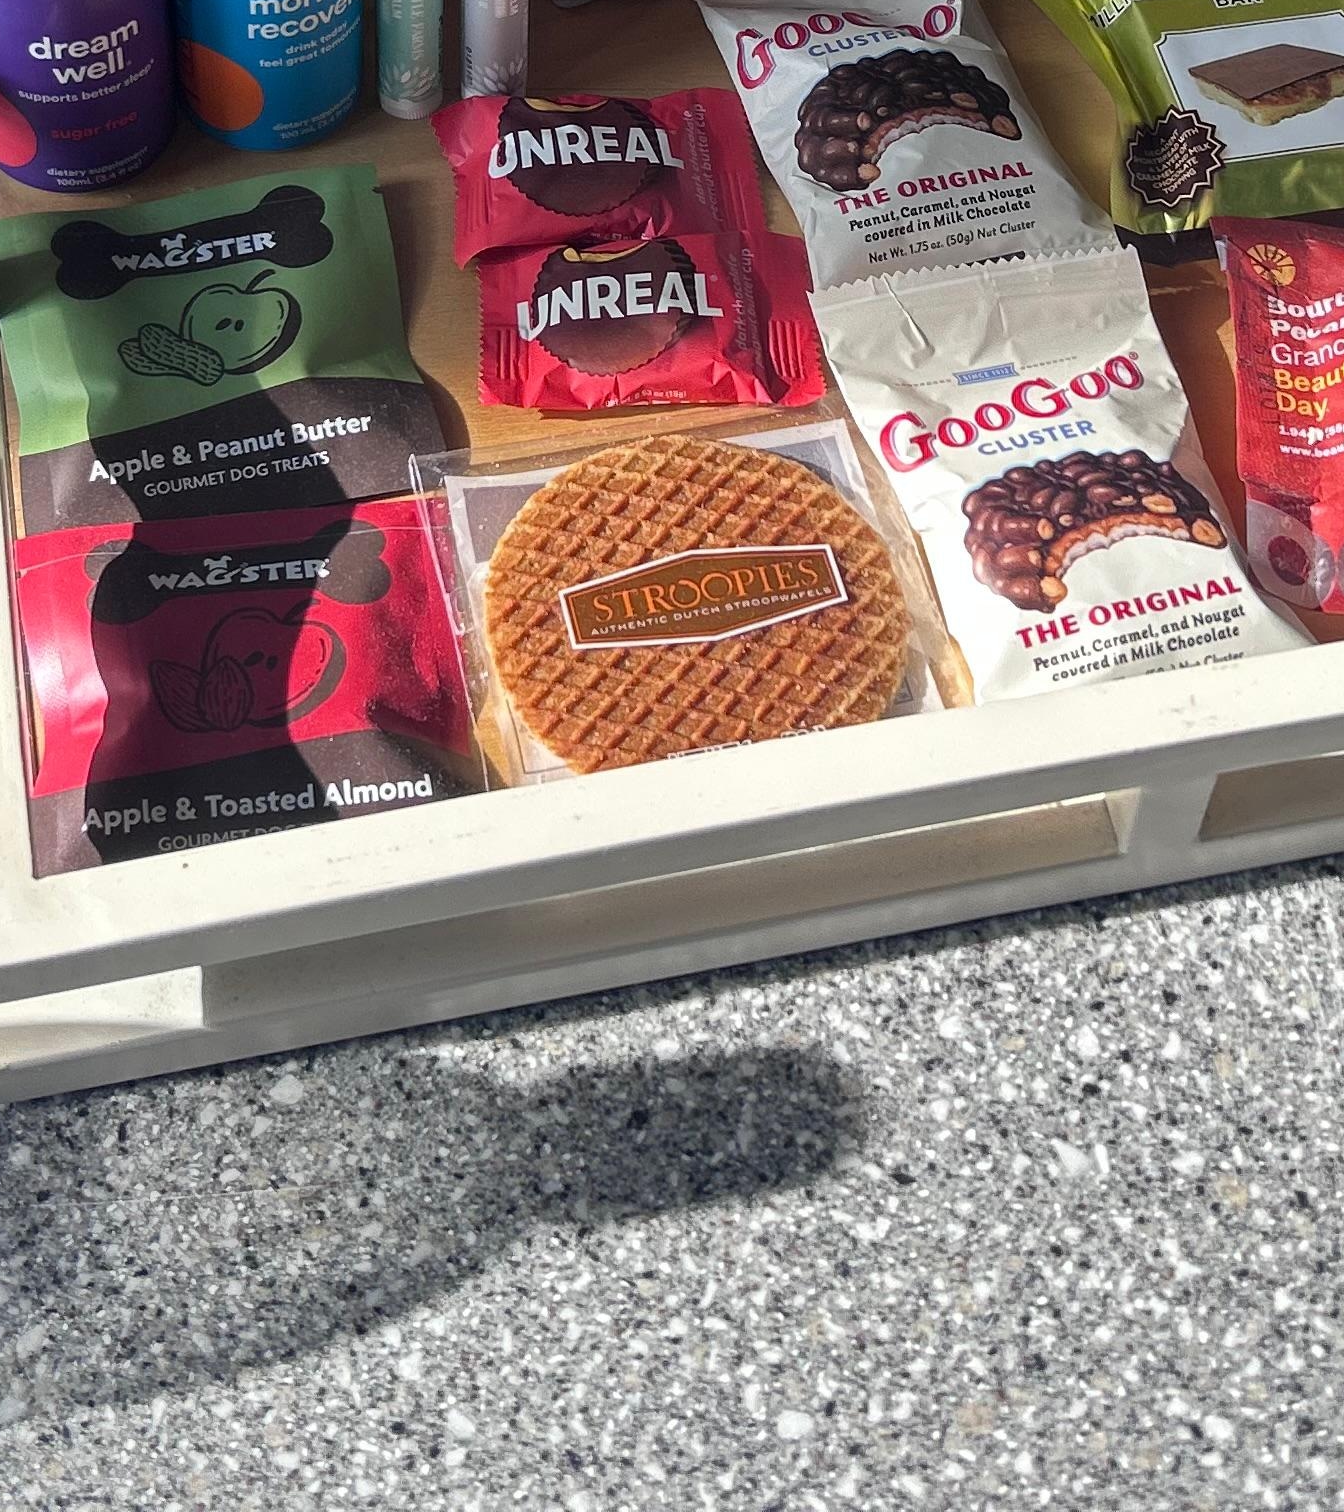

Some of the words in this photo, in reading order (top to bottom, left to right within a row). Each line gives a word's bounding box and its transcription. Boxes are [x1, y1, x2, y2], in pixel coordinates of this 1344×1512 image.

[28, 19, 139, 60] dream
[285, 39, 318, 55] drink
[286, 51, 318, 67] great
[52, 46, 125, 85] well
[18, 90, 79, 104] supports
[81, 82, 122, 101] better
[488, 125, 685, 179] UNREAL
[834, 188, 891, 215] THE
[897, 161, 1033, 198] ORIGINAL
[849, 210, 899, 232] Peanut,
[901, 197, 959, 218] Caramel,
[961, 192, 985, 206] and
[987, 184, 1036, 202] Nougat
[864, 225, 915, 243] covered
[917, 219, 930, 232] in
[934, 210, 964, 228] Milk
[966, 199, 1031, 220] Chocolate
[868, 252, 887, 264] Net
[889, 246, 907, 259] Wt.
[909, 240, 929, 254] 1.75
[946, 233, 974, 248] (50g)
[977, 227, 997, 238] Nut
[999, 220, 1036, 235] Cluster
[516, 271, 725, 341] UNREAL
[1276, 391, 1329, 422] Day
[88, 448, 166, 485] Apple
[172, 445, 192, 467] &
[198, 430, 286, 462] Peanut
[291, 413, 372, 443] Butter
[977, 420, 1097, 456] CLUSTER
[143, 471, 225, 497] GOURMET
[229, 461, 268, 484] DOG
[271, 450, 330, 475] TREATS
[591, 614, 668, 636] AUTHENTIC
[673, 606, 721, 620] DUTCH
[725, 587, 833, 612] STROOPWAFELS
[593, 559, 818, 622] STROOPIES
[1016, 614, 1080, 649] THE
[1088, 576, 1242, 626] ORIGINAL
[1033, 645, 1092, 672] Peanut,
[1092, 624, 1159, 652] Caramel,
[1161, 618, 1190, 635] and
[1192, 604, 1246, 628] Nougat
[1052, 655, 1110, 681] covered
[1113, 649, 1128, 666] in
[1130, 641, 1164, 662] Milk
[1167, 625, 1240, 652] Chocolate
[81, 799, 167, 835] Apple
[175, 797, 197, 821] &
[205, 784, 315, 819] Toasted
[323, 774, 433, 807] Almond
